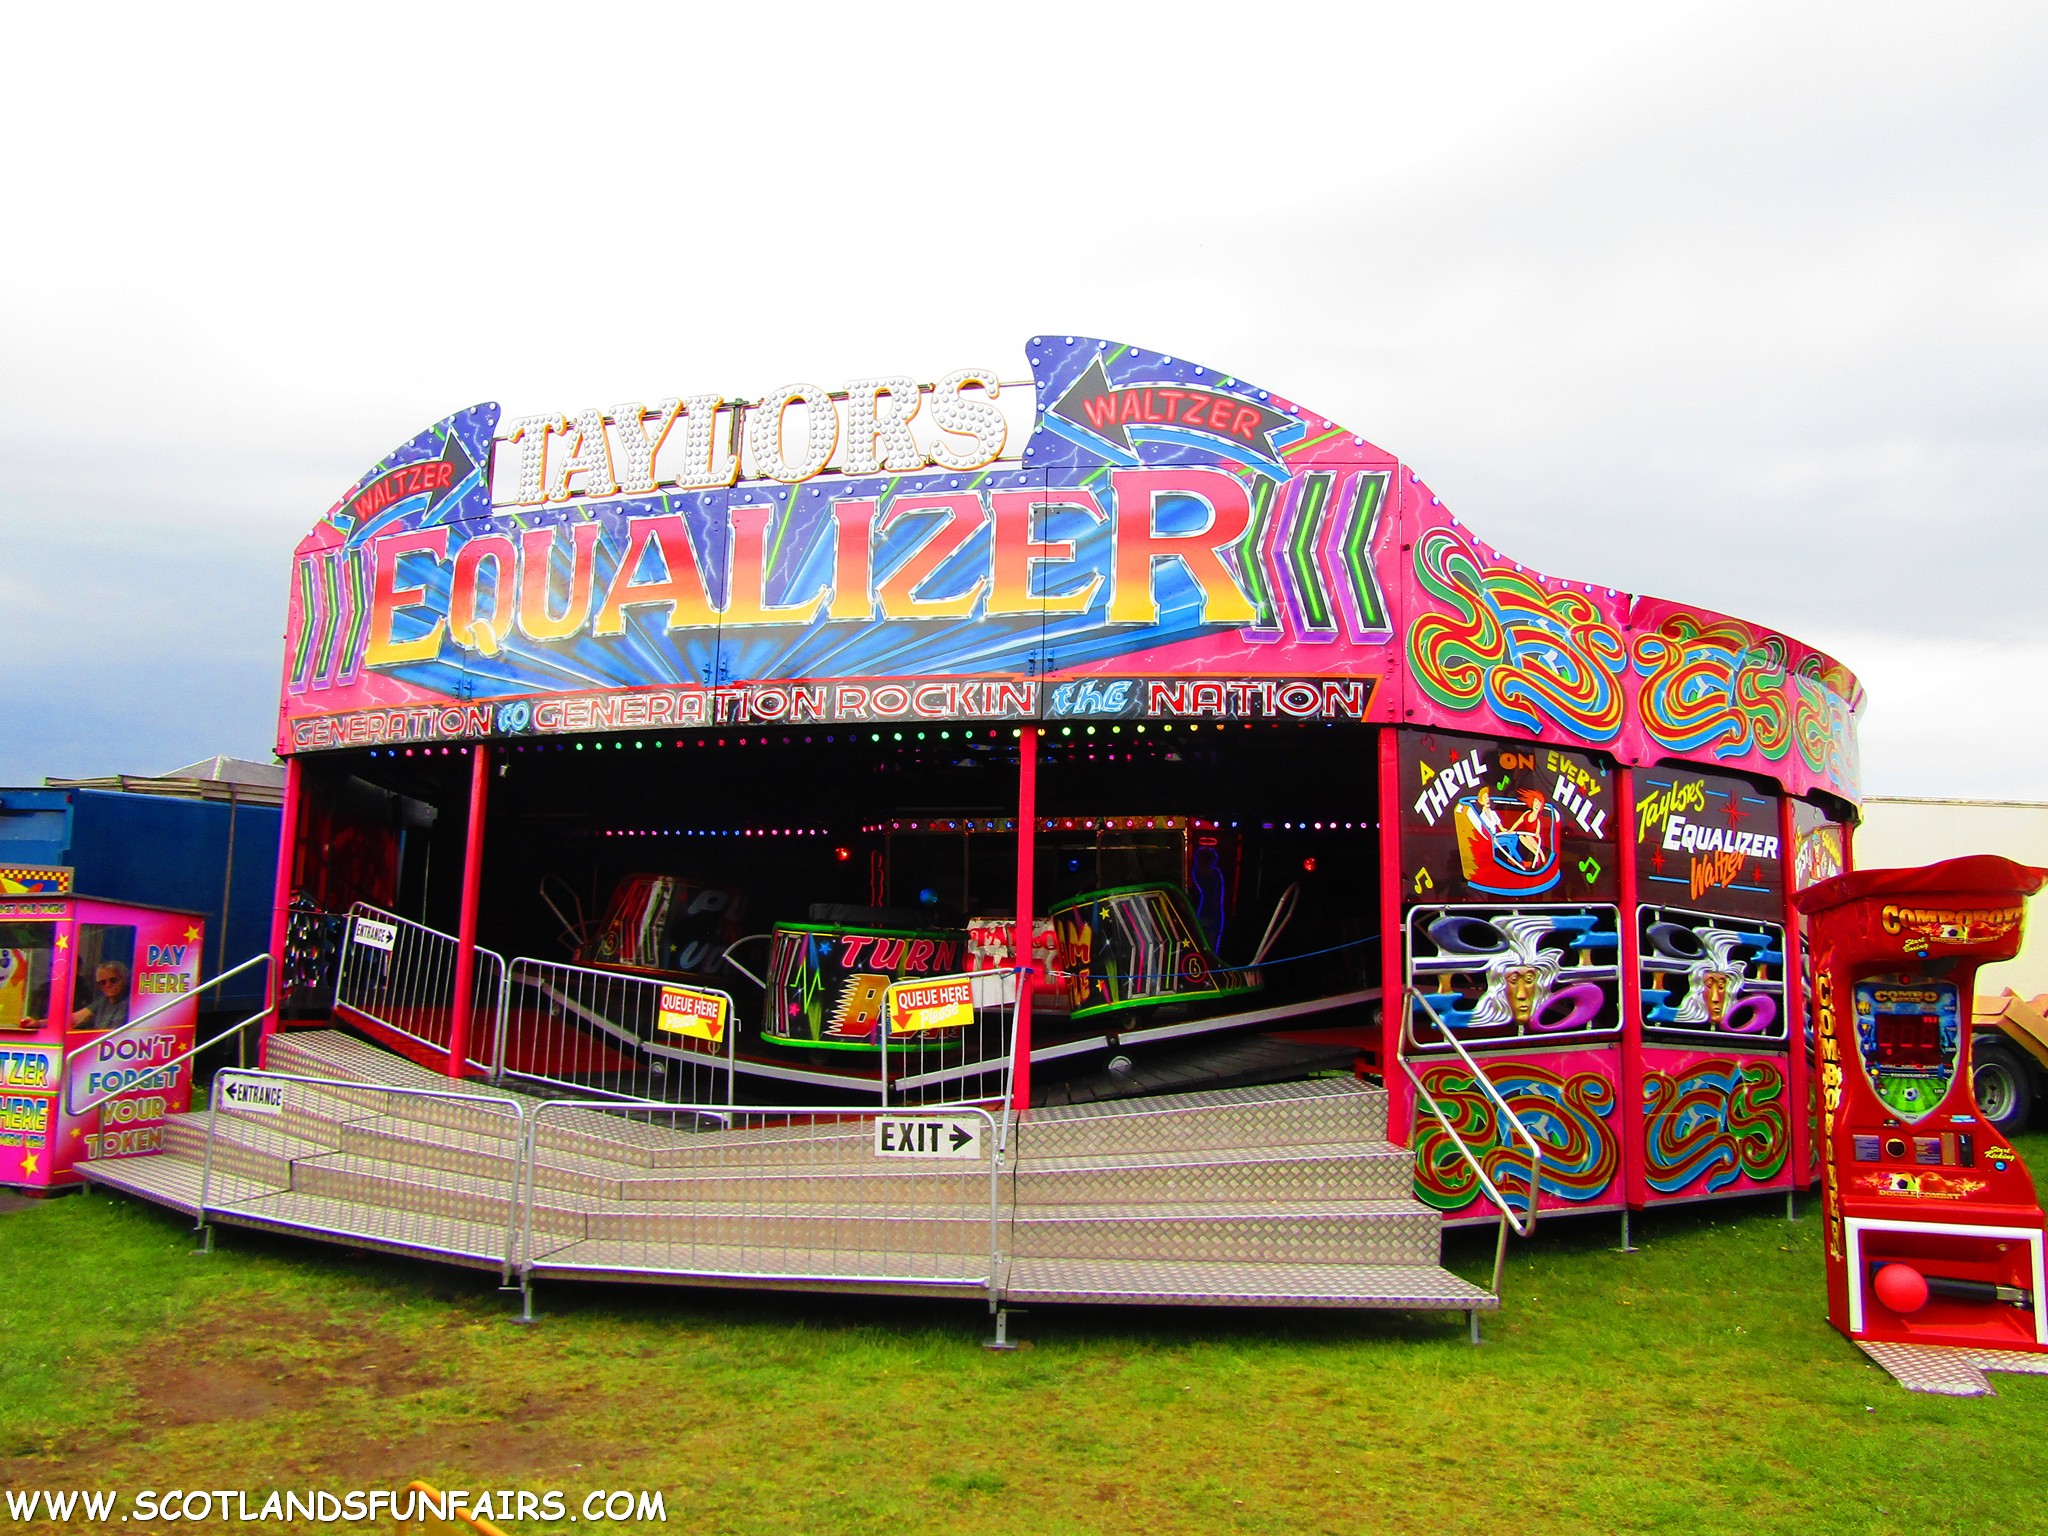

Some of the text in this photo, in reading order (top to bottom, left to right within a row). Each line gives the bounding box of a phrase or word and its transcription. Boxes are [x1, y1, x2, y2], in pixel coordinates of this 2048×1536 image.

[1083, 384, 1263, 442] WALTZER
[507, 368, 1007, 506] TAYLORS
[353, 461, 454, 523] WALTZER
[364, 466, 1262, 668] EQUALIZER
[293, 705, 494, 748] GENERATION
[535, 685, 826, 732] GENERATION
[835, 681, 1035, 719] ROCKIN
[1051, 680, 1134, 715] the
[1148, 681, 1365, 718] NATION
[1413, 749, 1608, 840] A THRILL ON EVERY HILL
[1662, 815, 1779, 859] EQUALIZER
[356, 923, 386, 942] ENTRANCE
[147, 945, 187, 966] PAY
[840, 935, 957, 972] TURN
[1187, 957, 1202, 979] 6
[139, 973, 190, 994] HERE
[898, 985, 970, 1010] QUEUE HERE
[1875, 990, 1938, 1002] COMBO
[662, 993, 719, 1018] QUEUE HERE
[920, 1001, 959, 1029] Please
[99, 1034, 176, 1062] DON'T
[88, 1064, 182, 1094] FORGET
[237, 1083, 283, 1107] ENTRANCE
[0, 1096, 48, 1132] HERE
[104, 1096, 167, 1125] YOUR
[881, 1122, 944, 1152] EXIT
[1989, 1145, 2011, 1155] Start
[1984, 1150, 2016, 1162] Kicking
[1918, 1191, 1961, 1200] COMBAT
